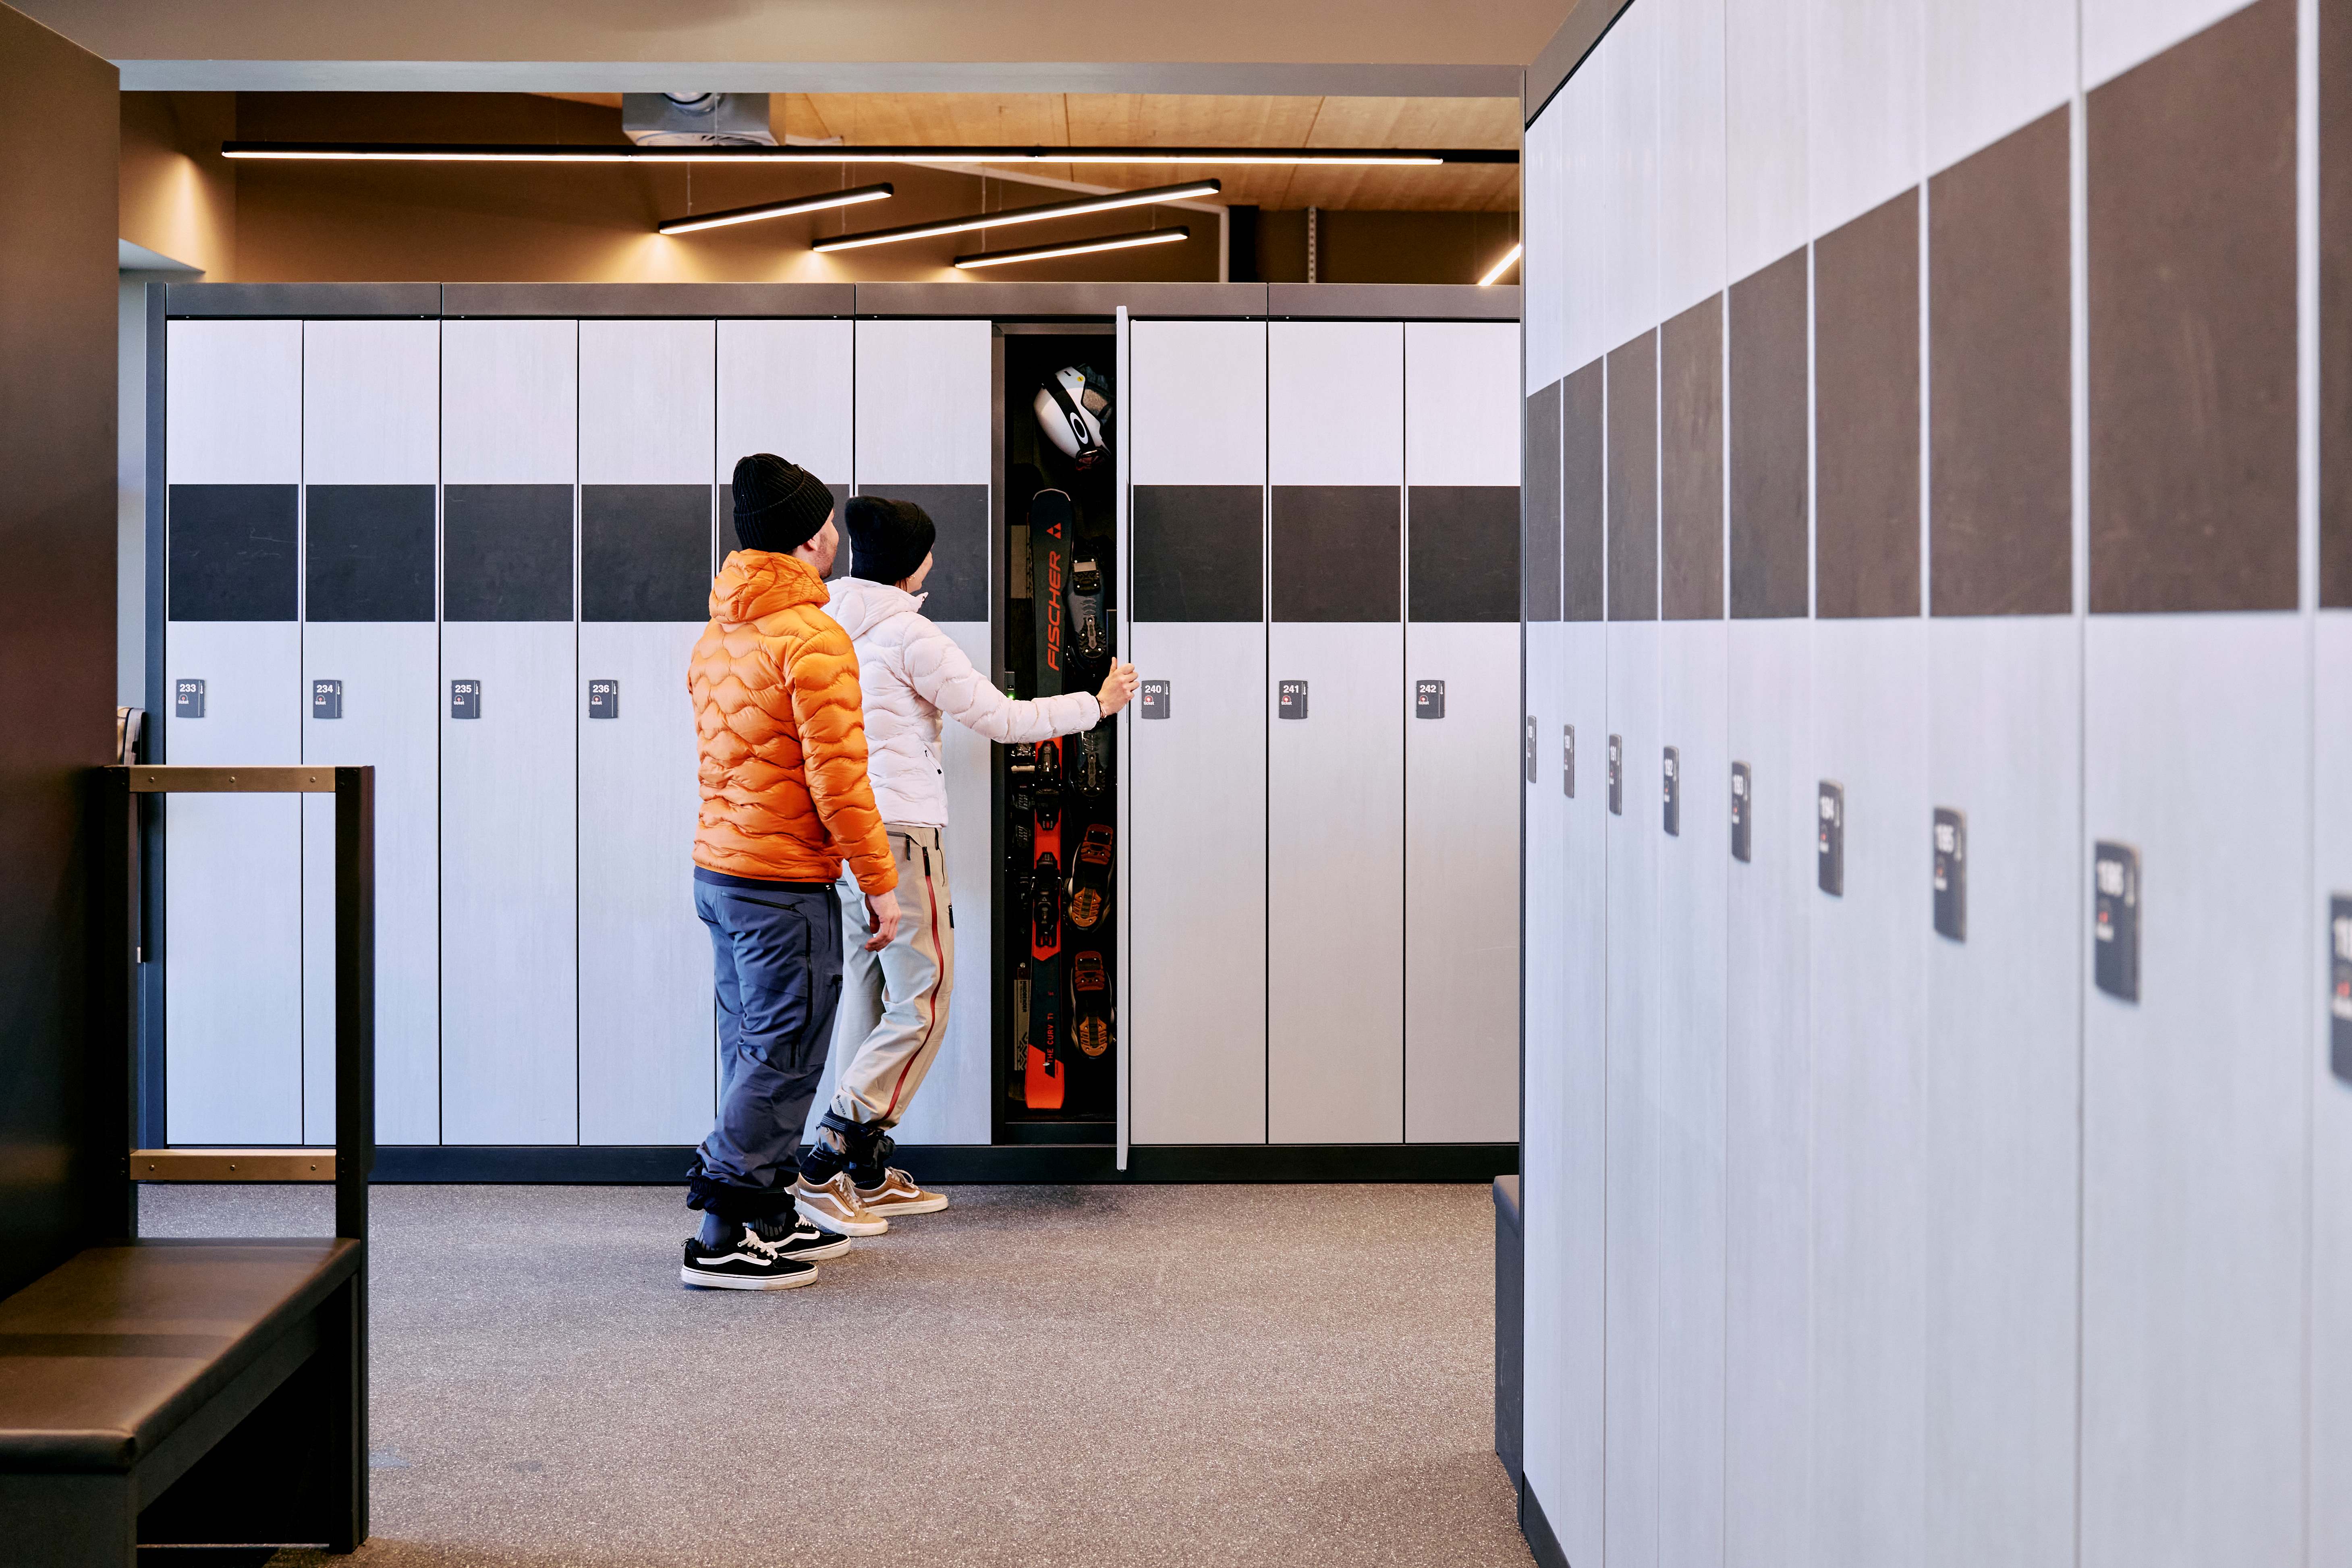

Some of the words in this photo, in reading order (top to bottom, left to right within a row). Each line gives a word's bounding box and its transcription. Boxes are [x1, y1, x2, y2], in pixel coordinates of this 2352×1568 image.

[1047, 550, 1061, 671] FISCHER
[180, 684, 196, 692] 233
[317, 684, 333, 693] 234
[455, 684, 472, 693] 235
[593, 684, 610, 693] 236
[1145, 685, 1161, 693] 240
[1283, 685, 1299, 693] 241
[1420, 685, 1437, 693] 242
[1664, 759, 1673, 776] 192
[1732, 774, 1744, 796] 193
